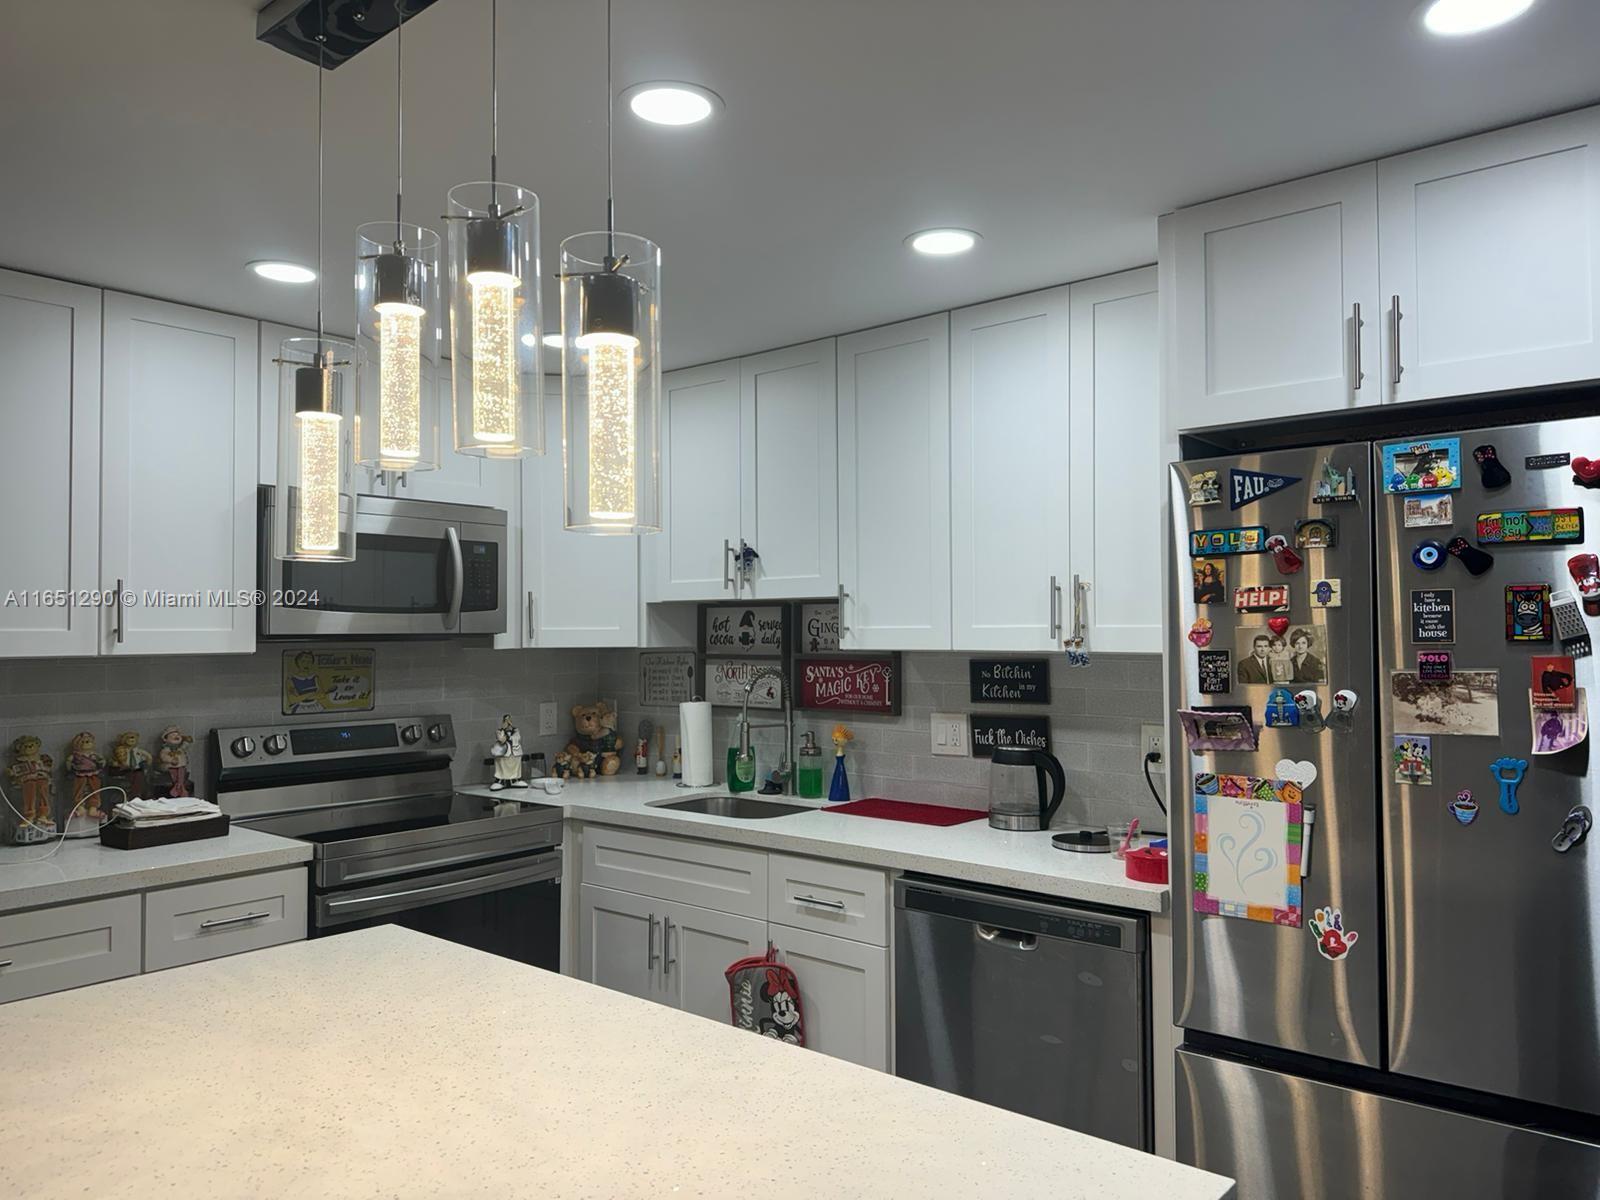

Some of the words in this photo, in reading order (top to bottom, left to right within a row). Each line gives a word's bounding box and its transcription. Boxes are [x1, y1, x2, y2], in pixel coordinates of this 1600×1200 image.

[1505, 515, 1525, 526] not
[1235, 590, 1288, 608] HELP!
[1413, 602, 1450, 612] kitchen
[713, 616, 731, 633] hot
[1418, 627, 1448, 637] house
[709, 633, 735, 646] cocoa
[760, 630, 781, 649] daily
[1419, 654, 1449, 663] YOLO
[806, 665, 844, 682] SANTA'S
[815, 676, 852, 698] MAGIC
[856, 667, 878, 694] KEY
[982, 683, 1021, 698] Kitchen
[974, 729, 995, 745] Fuck
[1015, 729, 1047, 748] Dishes
[739, 979, 761, 1033] innie
